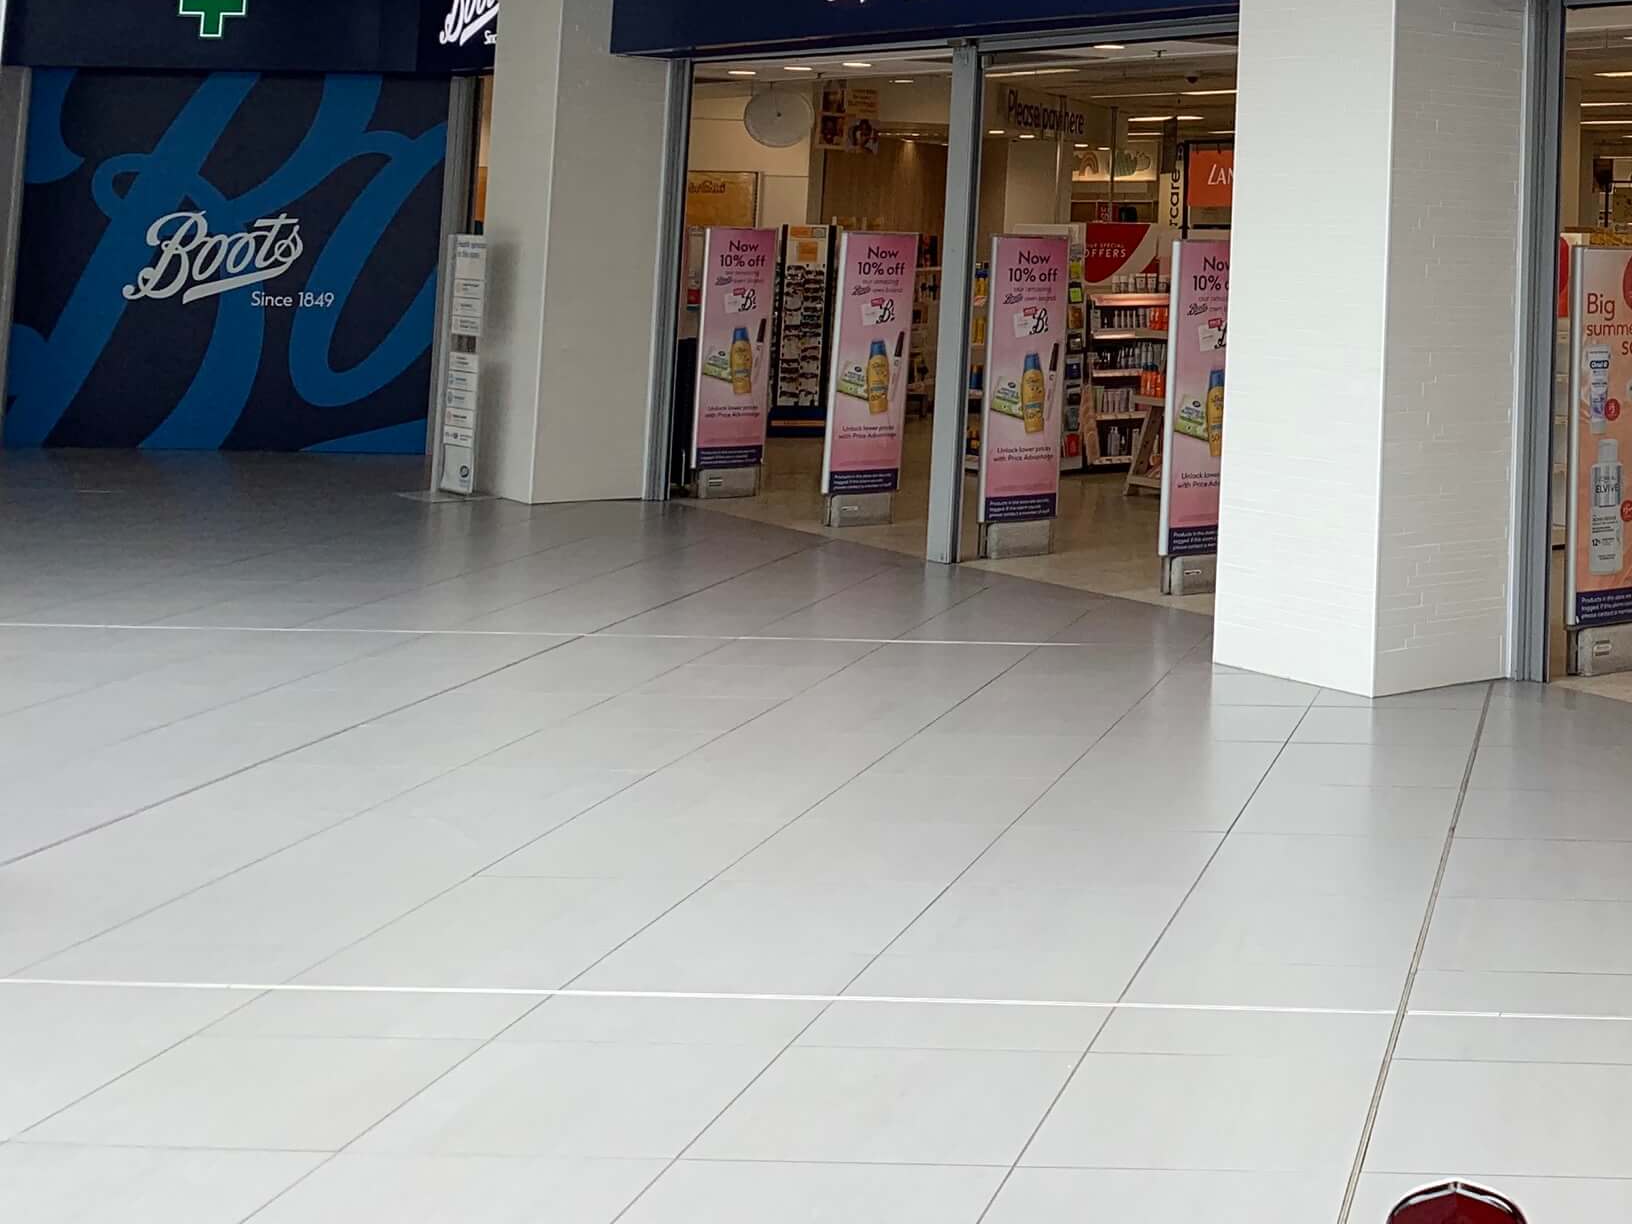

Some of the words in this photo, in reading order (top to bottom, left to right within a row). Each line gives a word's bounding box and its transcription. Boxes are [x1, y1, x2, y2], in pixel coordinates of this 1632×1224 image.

[1007, 88, 1041, 128] Please
[729, 239, 759, 253] Now
[867, 245, 899, 259] Now
[122, 210, 303, 304] Boots
[720, 254, 745, 268] 10%
[747, 254, 765, 268] off
[1018, 250, 1051, 265] Now
[857, 261, 885, 276] 10%
[887, 261, 905, 276] off
[1008, 267, 1036, 283] 10%
[1038, 267, 1058, 283] off
[1193, 275, 1222, 291] 10%
[251, 291, 293, 307] Since
[299, 292, 334, 308] 1849
[1587, 292, 1616, 322] Big
